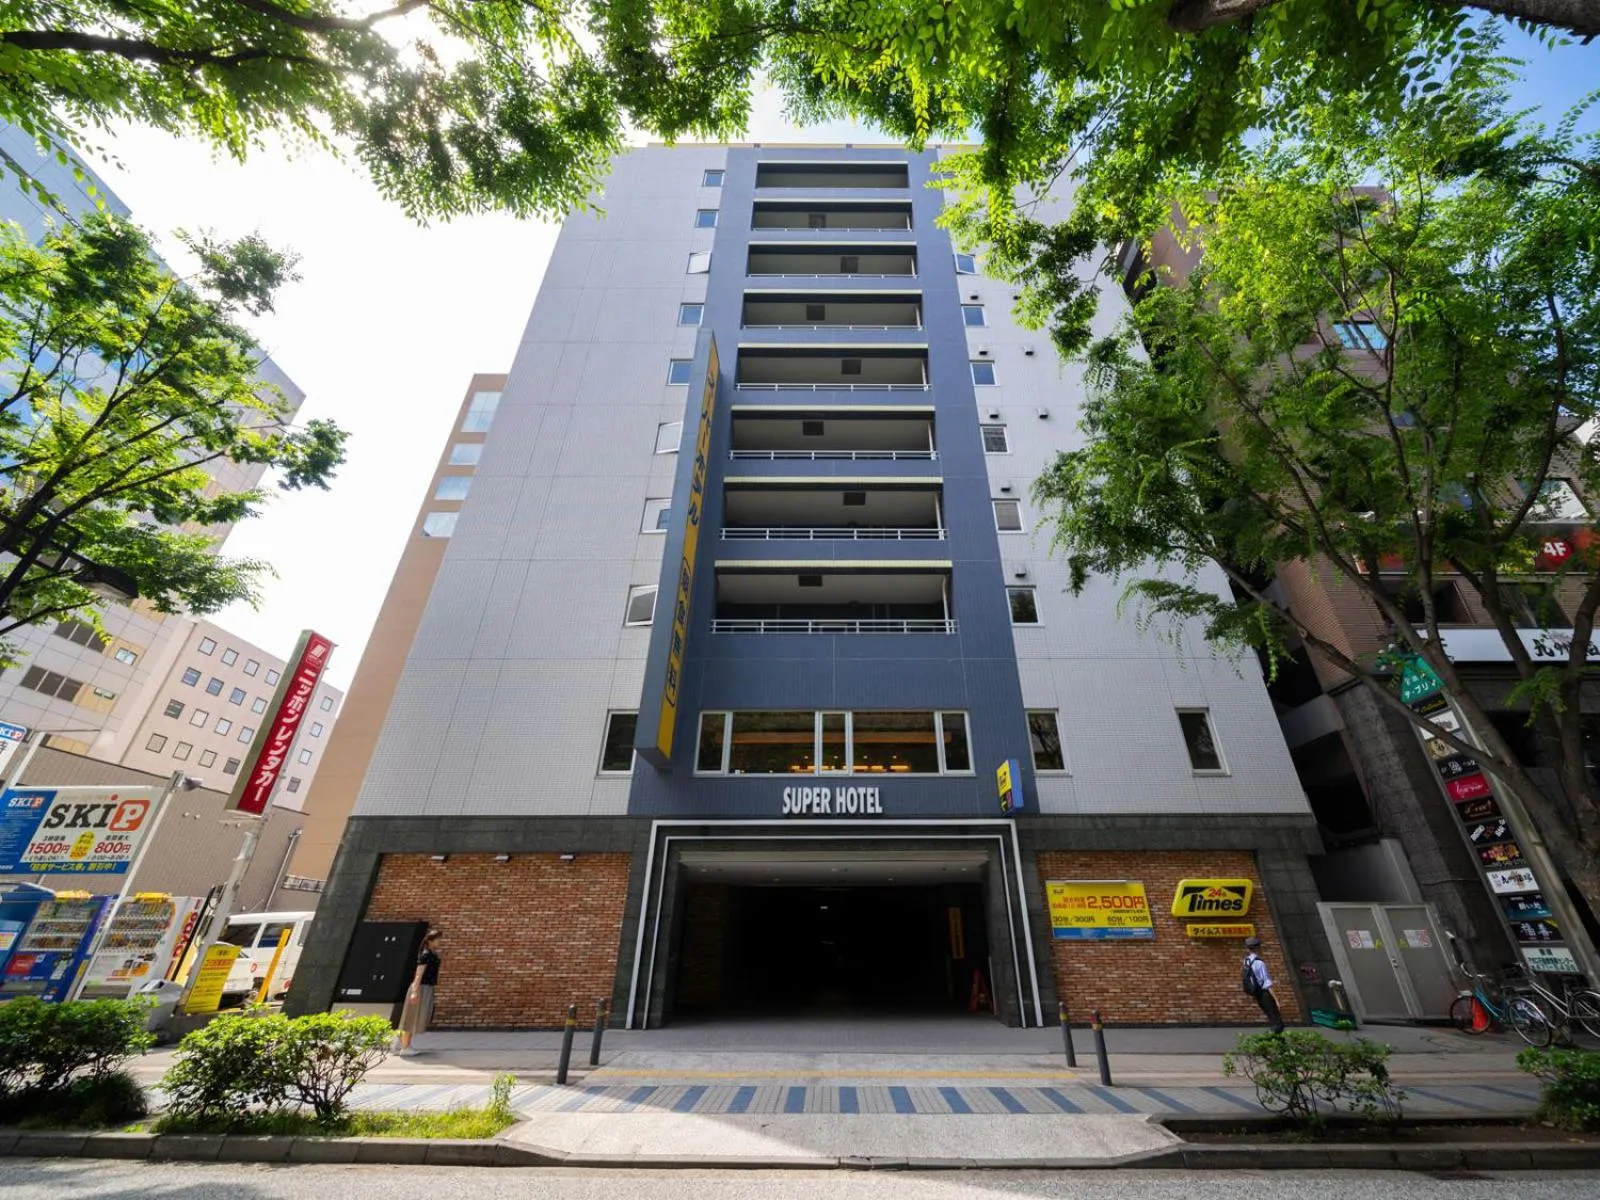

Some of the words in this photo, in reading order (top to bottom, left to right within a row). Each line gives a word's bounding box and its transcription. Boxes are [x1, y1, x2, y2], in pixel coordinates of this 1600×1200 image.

[1544, 542, 1567, 556] 4F
[254, 669, 317, 802] ニッポンレンタカー
[782, 786, 831, 814] SUPER
[836, 786, 883, 814] HOTEL
[28, 842, 71, 854] 1500円
[94, 842, 132, 854] 800円
[1087, 895, 1145, 910] 2,500円
[1188, 893, 1244, 912] Times
